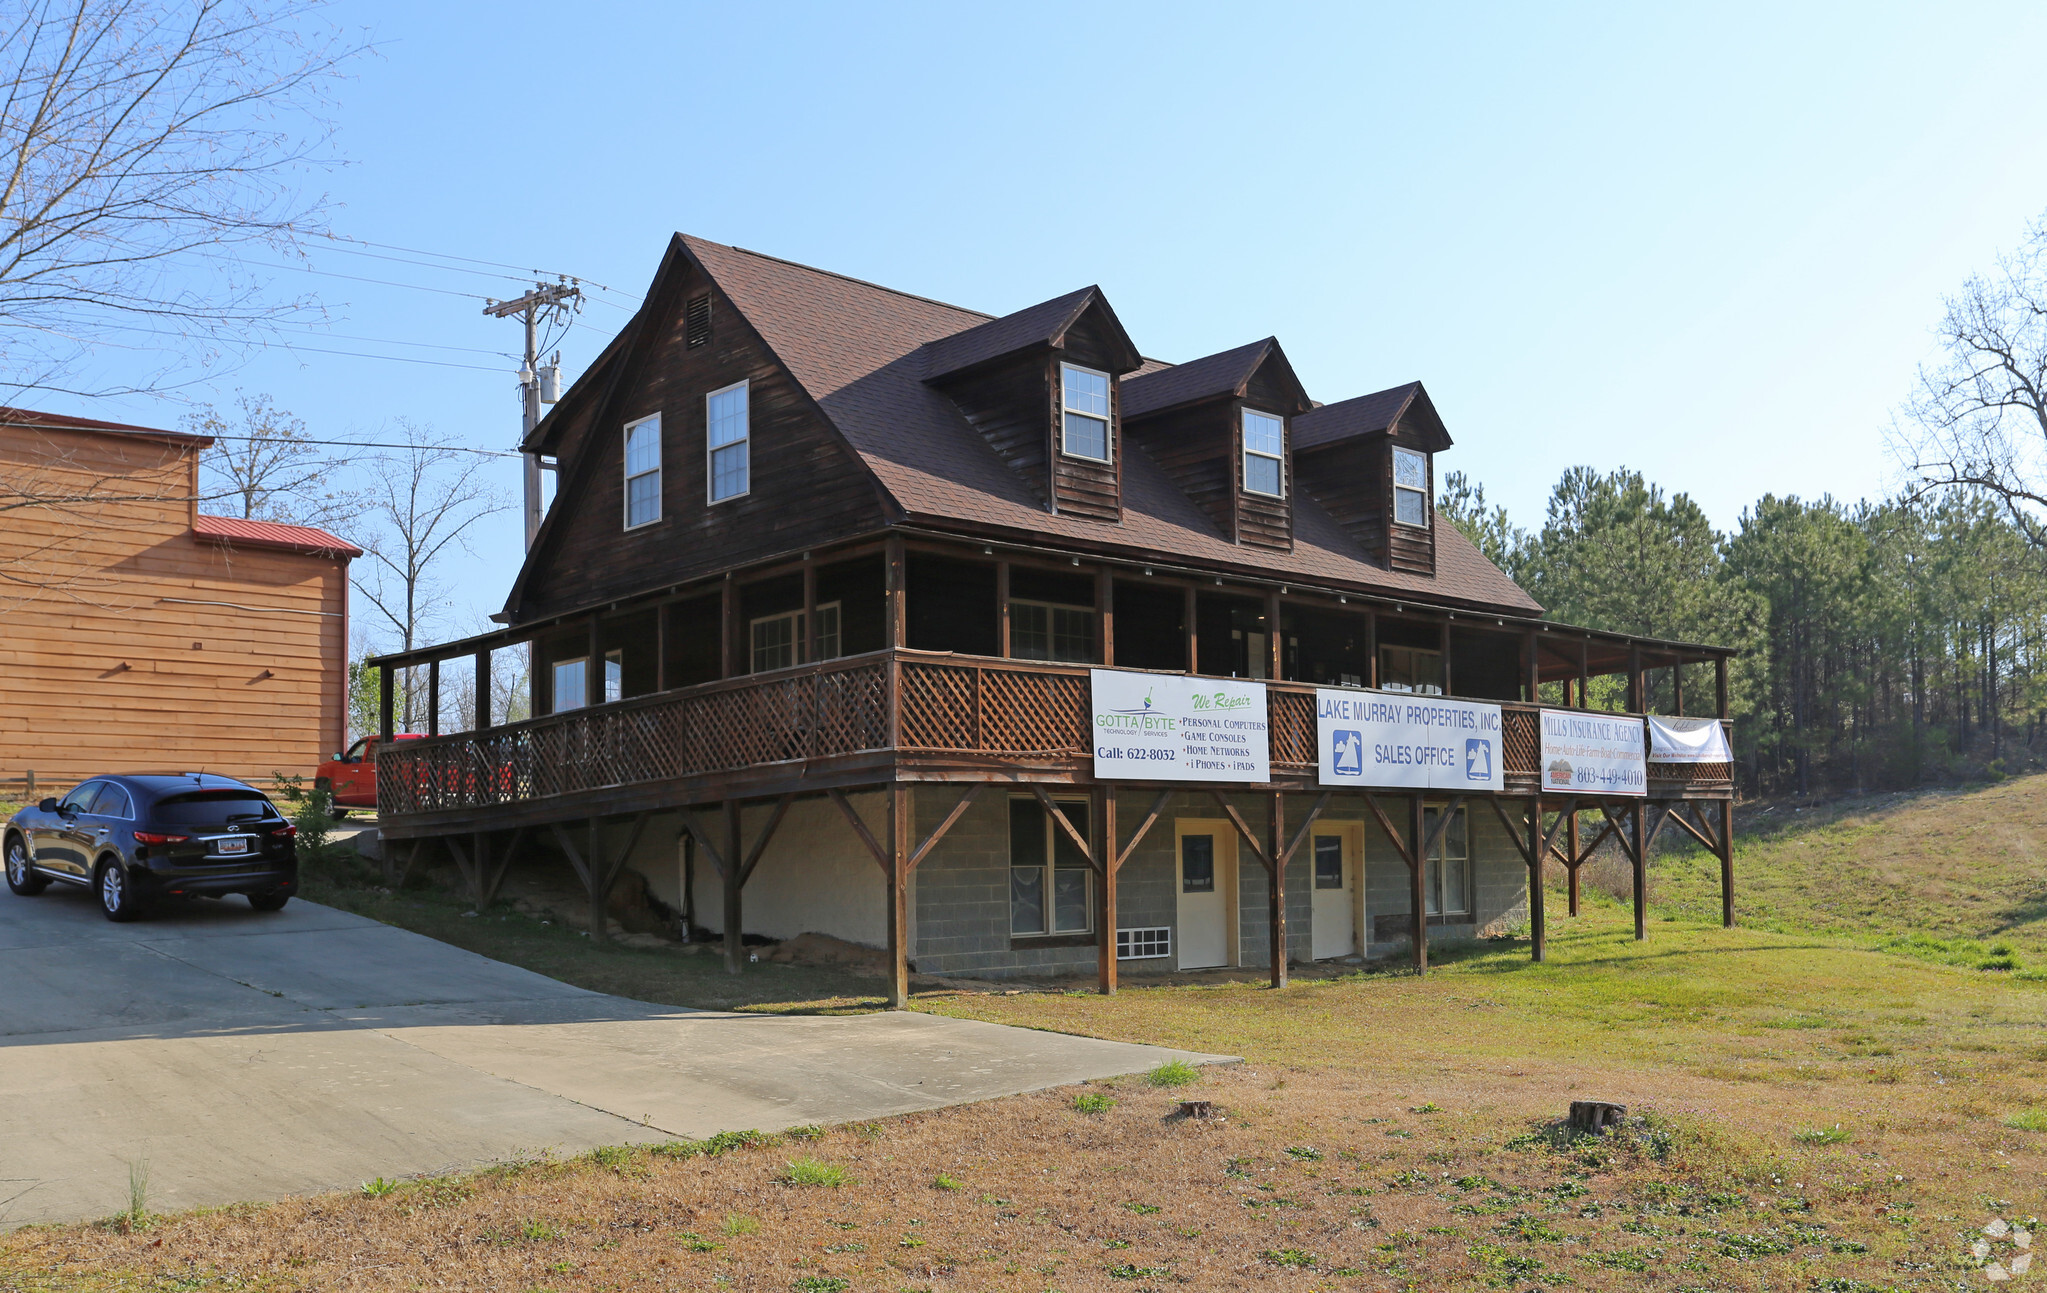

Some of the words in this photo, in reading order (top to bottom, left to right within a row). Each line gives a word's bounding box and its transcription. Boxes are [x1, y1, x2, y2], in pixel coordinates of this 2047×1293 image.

[1192, 694, 1210, 709] We
[1214, 692, 1251, 711] Repair
[1096, 714, 1139, 728] GOTTA
[1145, 717, 1176, 730] BYTE
[1318, 698, 1350, 720] LAKE
[1353, 701, 1402, 724] MURRAY
[1406, 705, 1478, 733] PROPERTIES,
[1480, 711, 1501, 731] INC.
[1182, 717, 1221, 728] PERSONAL
[1224, 719, 1266, 731] COMPUTERS
[1543, 716, 1567, 737] MILLS
[1569, 719, 1611, 740] INSURANCE
[1614, 723, 1641, 743] AGENCY
[1184, 731, 1206, 741] GAME
[1209, 732, 1246, 743] CONSOLES
[1097, 746, 1123, 759] Call:
[1127, 748, 1175, 760] 622-8032
[1186, 745, 1208, 755] HOME
[1211, 746, 1250, 757] NETWORKS
[1375, 744, 1412, 765] SALES
[1415, 745, 1455, 766] OFFICE
[1551, 771, 1571, 779] AMERICAN
[1577, 766, 1643, 786] 803-449-4010
